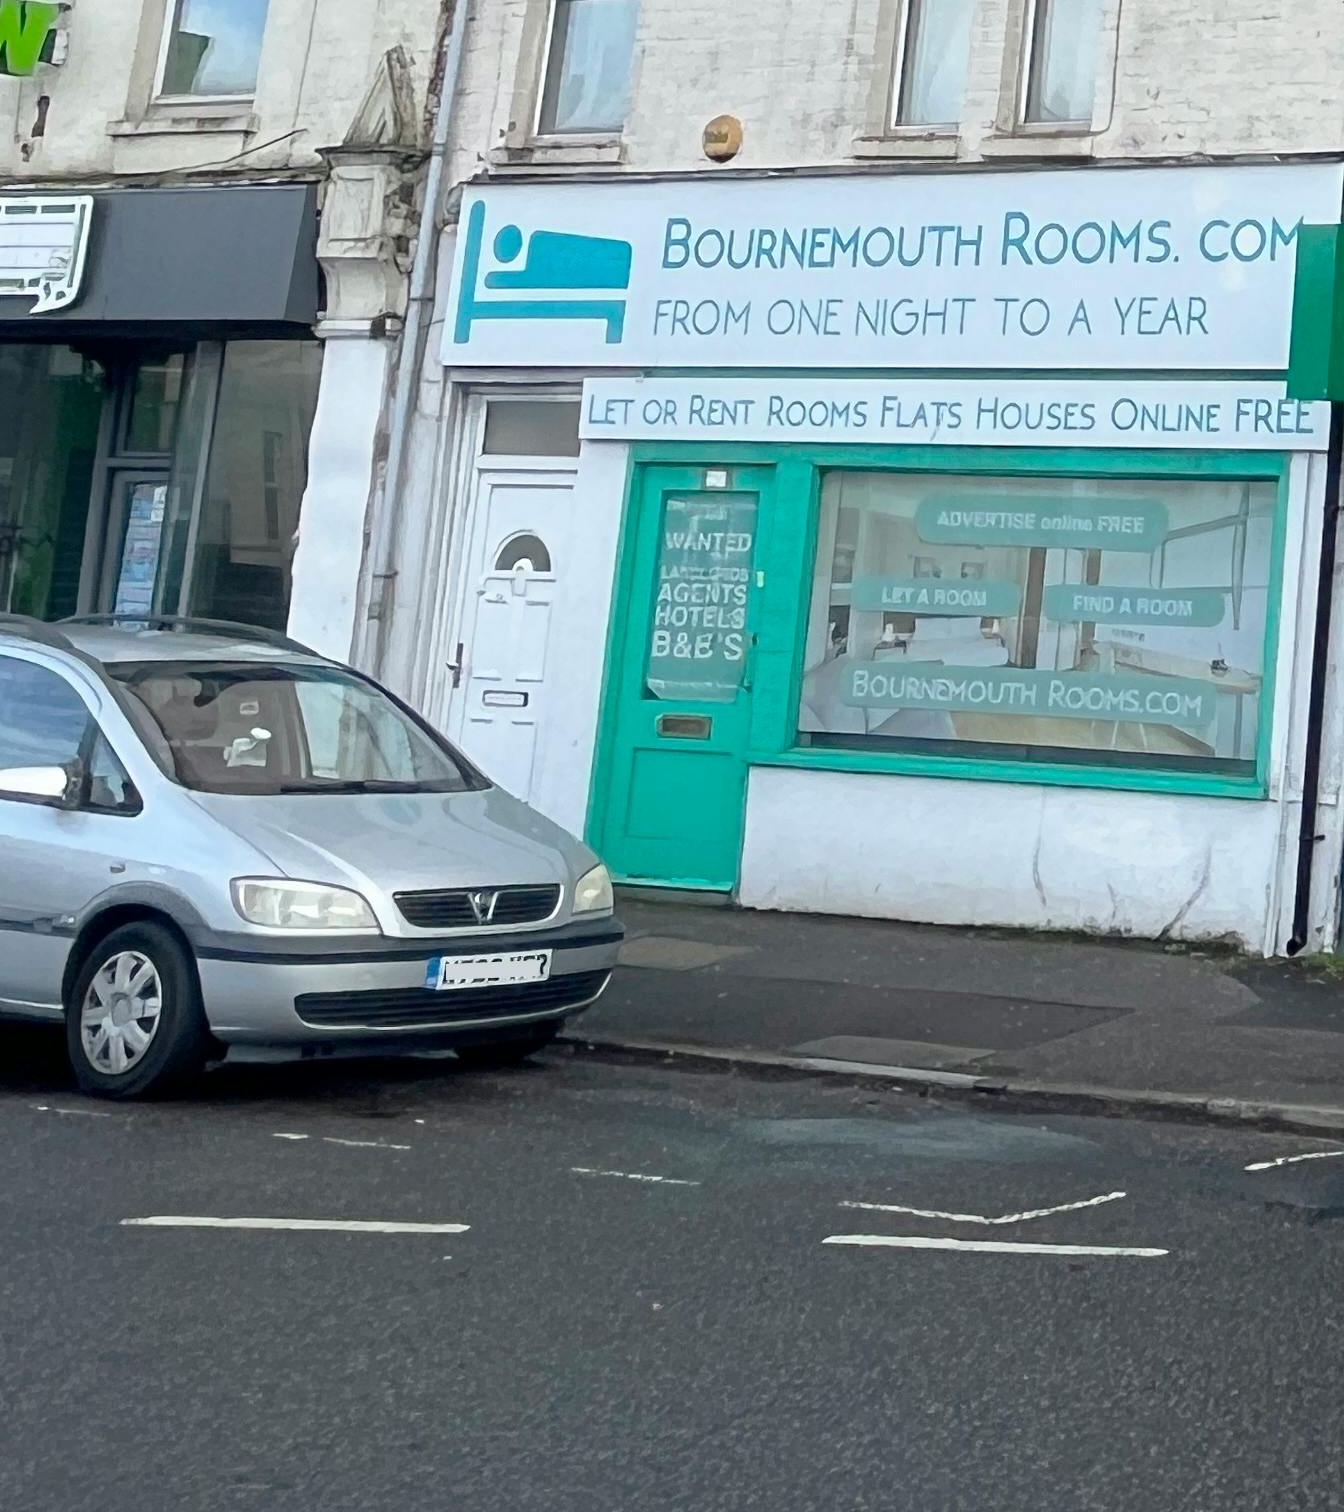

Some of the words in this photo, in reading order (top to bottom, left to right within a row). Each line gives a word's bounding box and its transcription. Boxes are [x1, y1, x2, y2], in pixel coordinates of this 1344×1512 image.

[661, 217, 983, 270] BOURNEMOUTH
[1001, 211, 1180, 266] ROOMS.
[653, 299, 751, 336] FROM
[767, 299, 843, 336] ONE
[855, 298, 976, 336] NIGHT
[994, 297, 1050, 336] TO
[1068, 298, 1092, 335] A
[1114, 297, 1209, 335] YEAR
[588, 394, 635, 426] LET
[642, 399, 678, 426] OR
[689, 394, 755, 426] RENT
[766, 395, 867, 428] ROOMS
[880, 395, 963, 429] FLATS
[976, 397, 1096, 430] HOUSES
[1111, 397, 1221, 433] ONLINE
[1235, 398, 1315, 434] FREE
[937, 510, 1036, 530] ADVERTISE
[1097, 516, 1145, 534] FREE
[665, 531, 752, 551] WANTED
[657, 582, 747, 606] AGENTS
[880, 586, 915, 603] LET
[917, 588, 931, 604] A
[934, 589, 988, 607] ROOM
[1072, 595, 1115, 614] FIND
[1118, 597, 1132, 614] A
[1136, 597, 1193, 617] ROOM
[654, 605, 745, 629] HOTELS
[852, 669, 1037, 706] BOURNEMOUTH
[1048, 679, 1203, 718] ROOMS.COM
